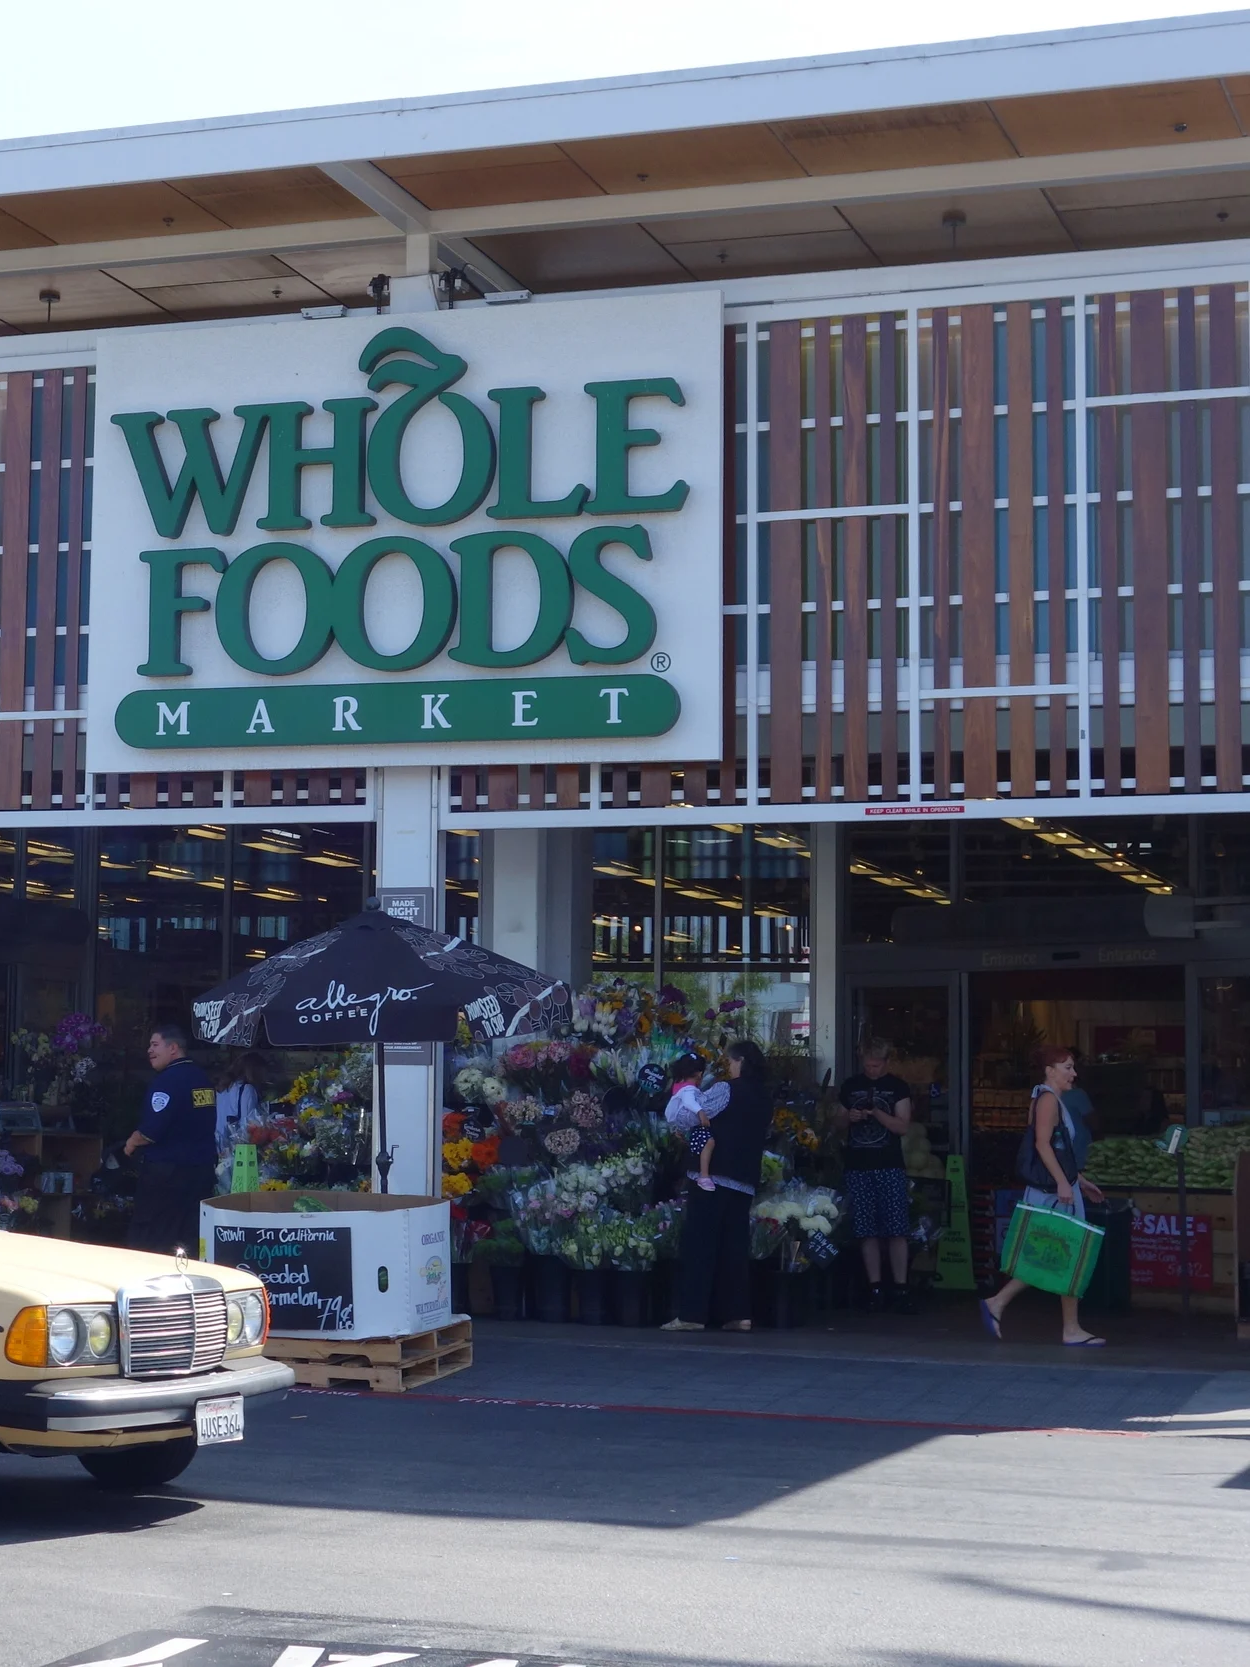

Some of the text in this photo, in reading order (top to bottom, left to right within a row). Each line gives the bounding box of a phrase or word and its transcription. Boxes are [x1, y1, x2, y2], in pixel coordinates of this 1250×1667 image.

[110, 376, 690, 539] WHOLE
[137, 523, 658, 677] FOODS
[154, 687, 630, 737] MARKET
[388, 908, 420, 916] RIGHT
[982, 947, 1158, 967] Entrance Entrance
[205, 1000, 225, 1021] SEED
[299, 1007, 369, 1024] COFFEE
[477, 994, 500, 1020] SEED
[207, 1018, 220, 1038] CUP
[490, 1014, 506, 1036] CUP
[216, 1227, 337, 1243] Grown In California
[244, 1243, 302, 1269] organic
[267, 1286, 318, 1306] ermelon
[200, 1413, 240, 1438] 4USE364
